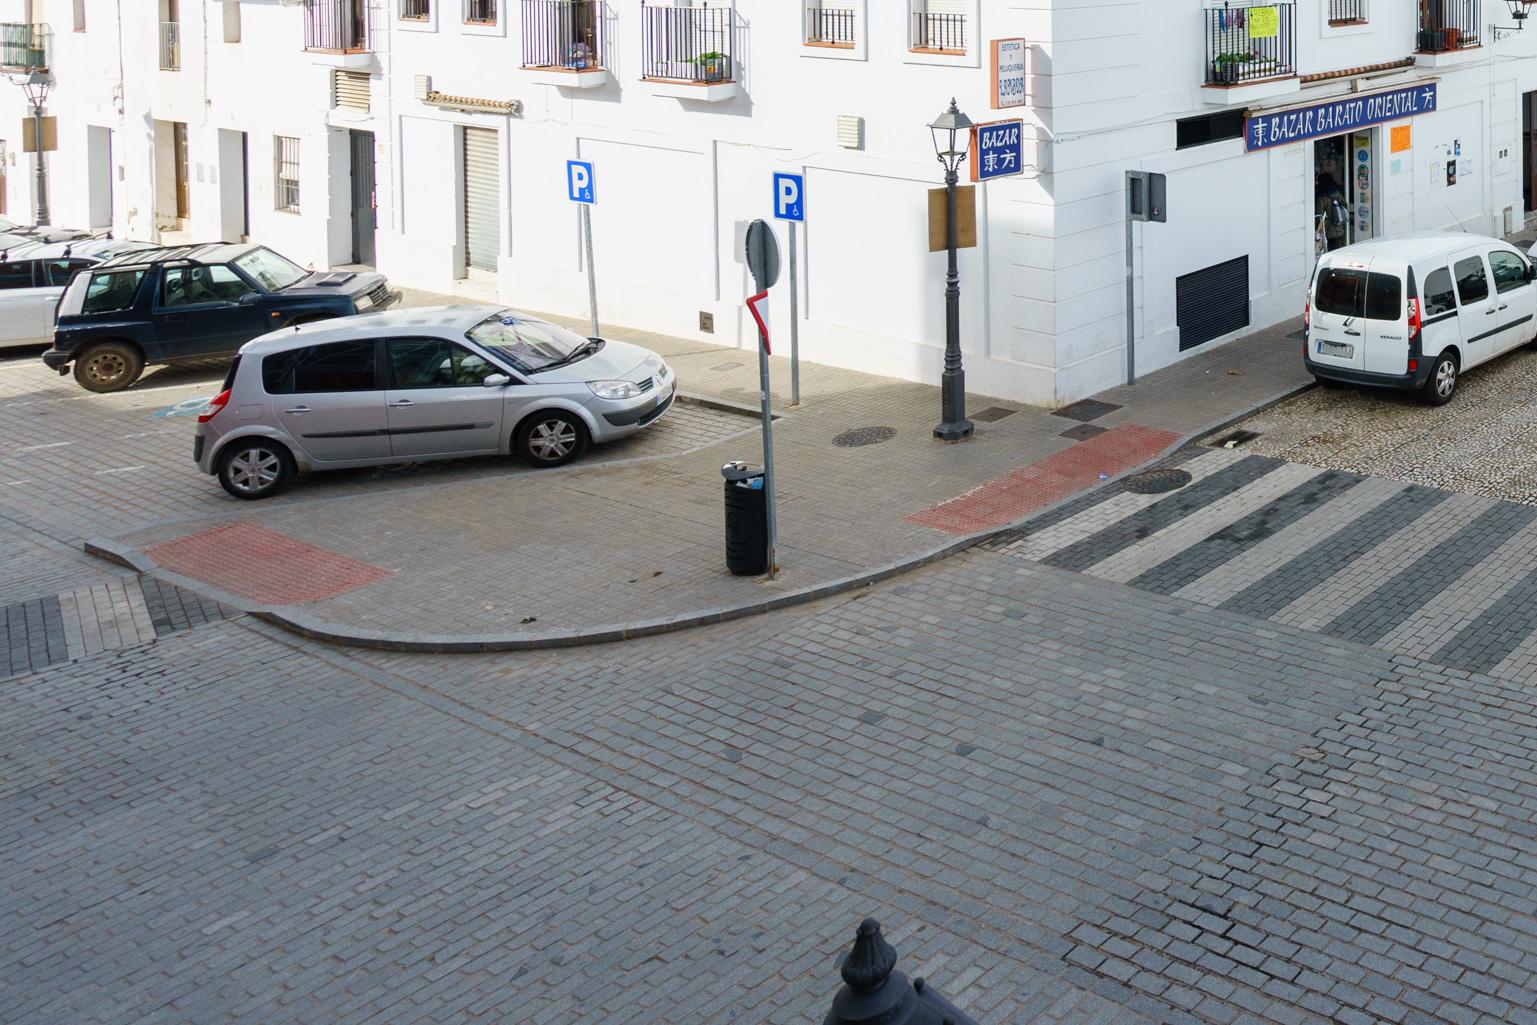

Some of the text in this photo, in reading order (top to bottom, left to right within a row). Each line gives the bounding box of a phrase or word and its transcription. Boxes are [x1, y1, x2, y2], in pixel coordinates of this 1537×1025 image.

[1253, 87, 1434, 147] 東 BAZAR BARATO ORIENTAL 方
[982, 127, 1018, 149] BAZAR
[984, 149, 1016, 172] 東方
[571, 164, 588, 198] P
[779, 177, 798, 215] P
